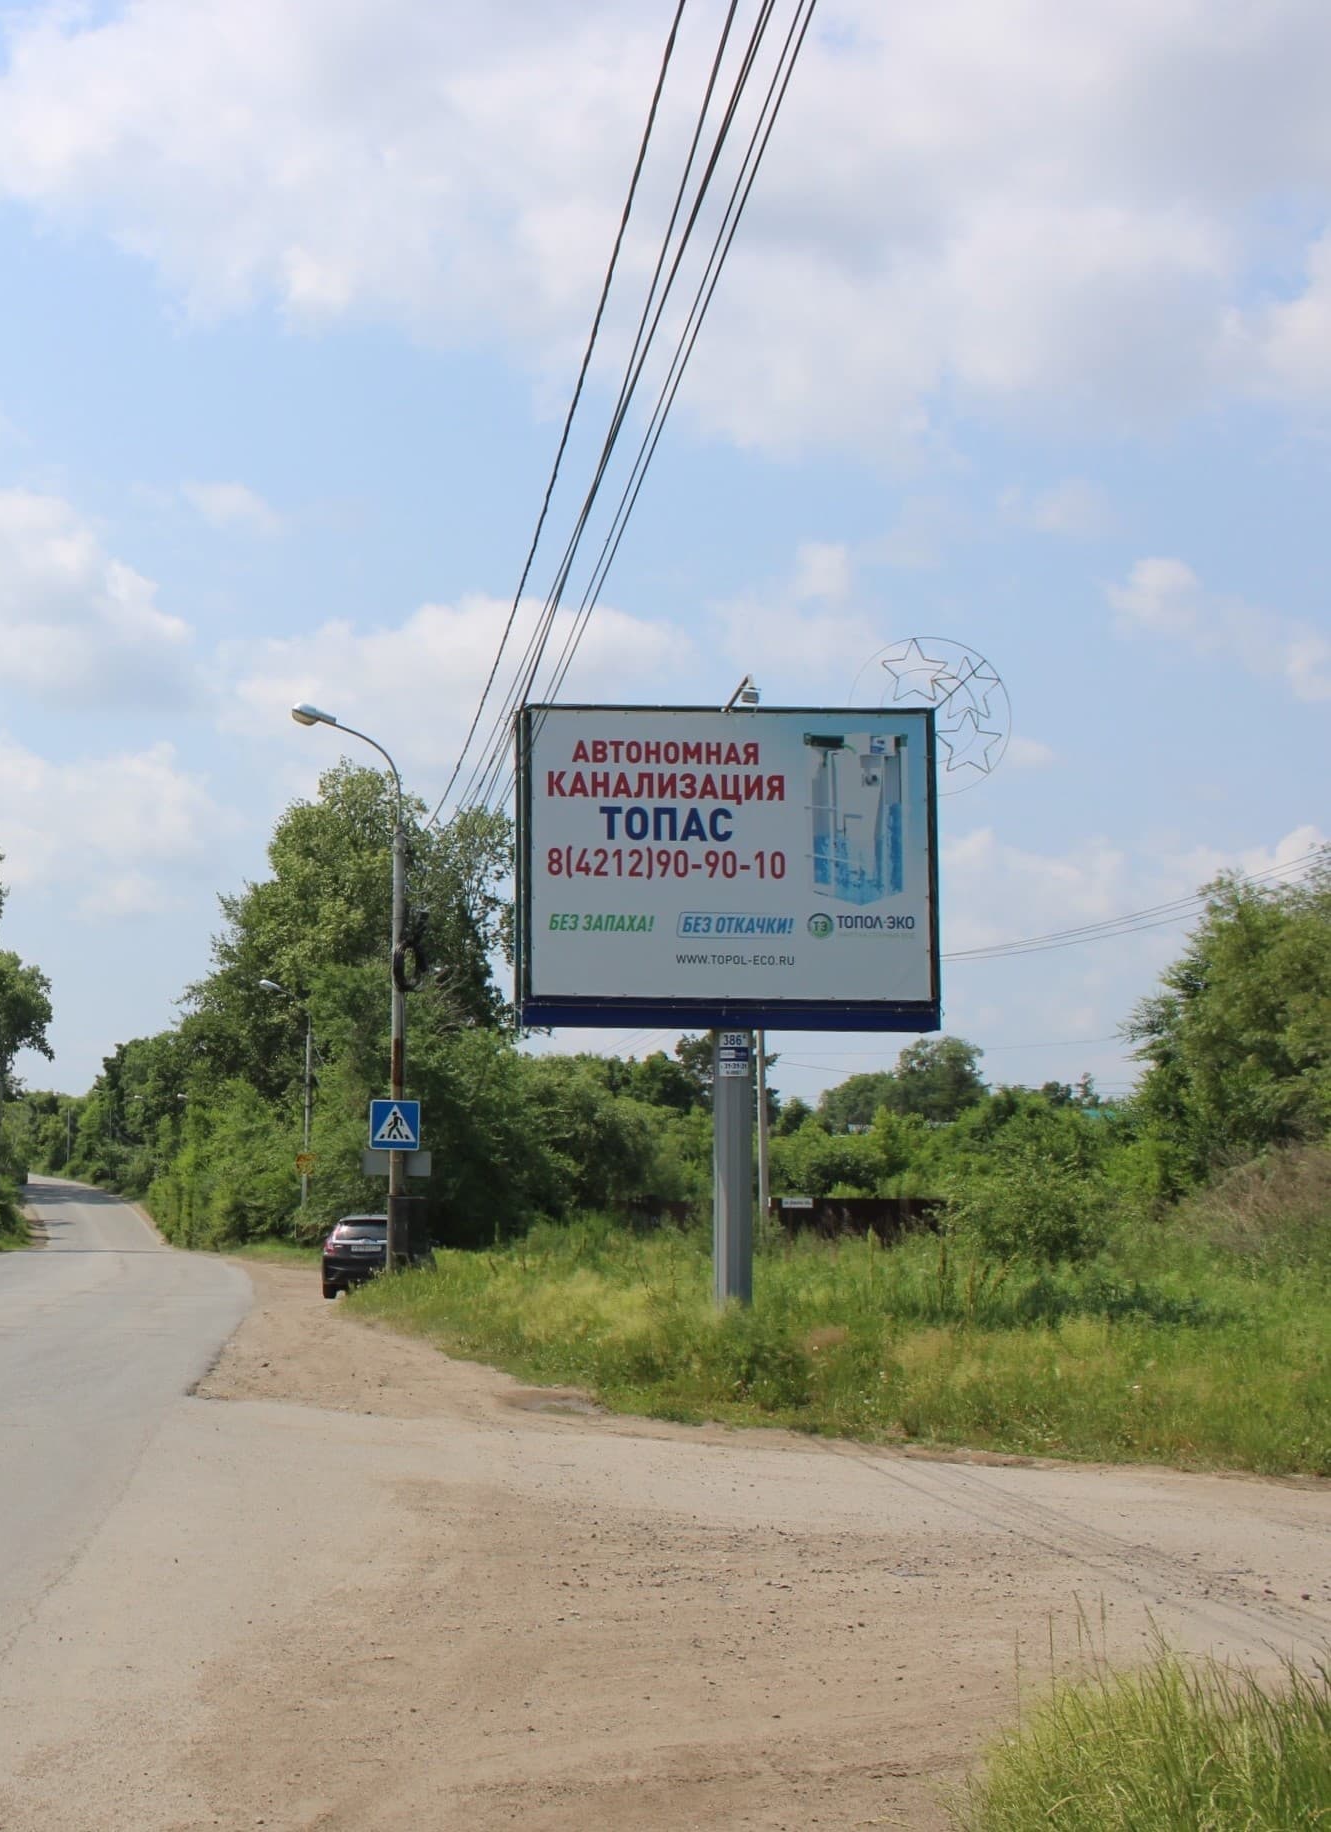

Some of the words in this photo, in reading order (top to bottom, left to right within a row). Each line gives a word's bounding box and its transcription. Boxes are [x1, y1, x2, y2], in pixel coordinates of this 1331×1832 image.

[572, 740, 759, 765] АВТОНОМНАЯ
[547, 771, 785, 805] КАНАЛИЗАЦИЯ
[599, 806, 733, 842] ТОПАС
[548, 846, 786, 880] 8(4212)90-90-10
[549, 914, 581, 931] БЕЗ
[583, 914, 654, 932] ЗАПАХА!
[682, 916, 713, 933] БЕЗ
[715, 917, 794, 935] ОТКАЧКИ!
[836, 915, 915, 929] ТОПОЛ-ЭКО
[676, 954, 796, 967] WWW.TOPOL-ECO.RU
